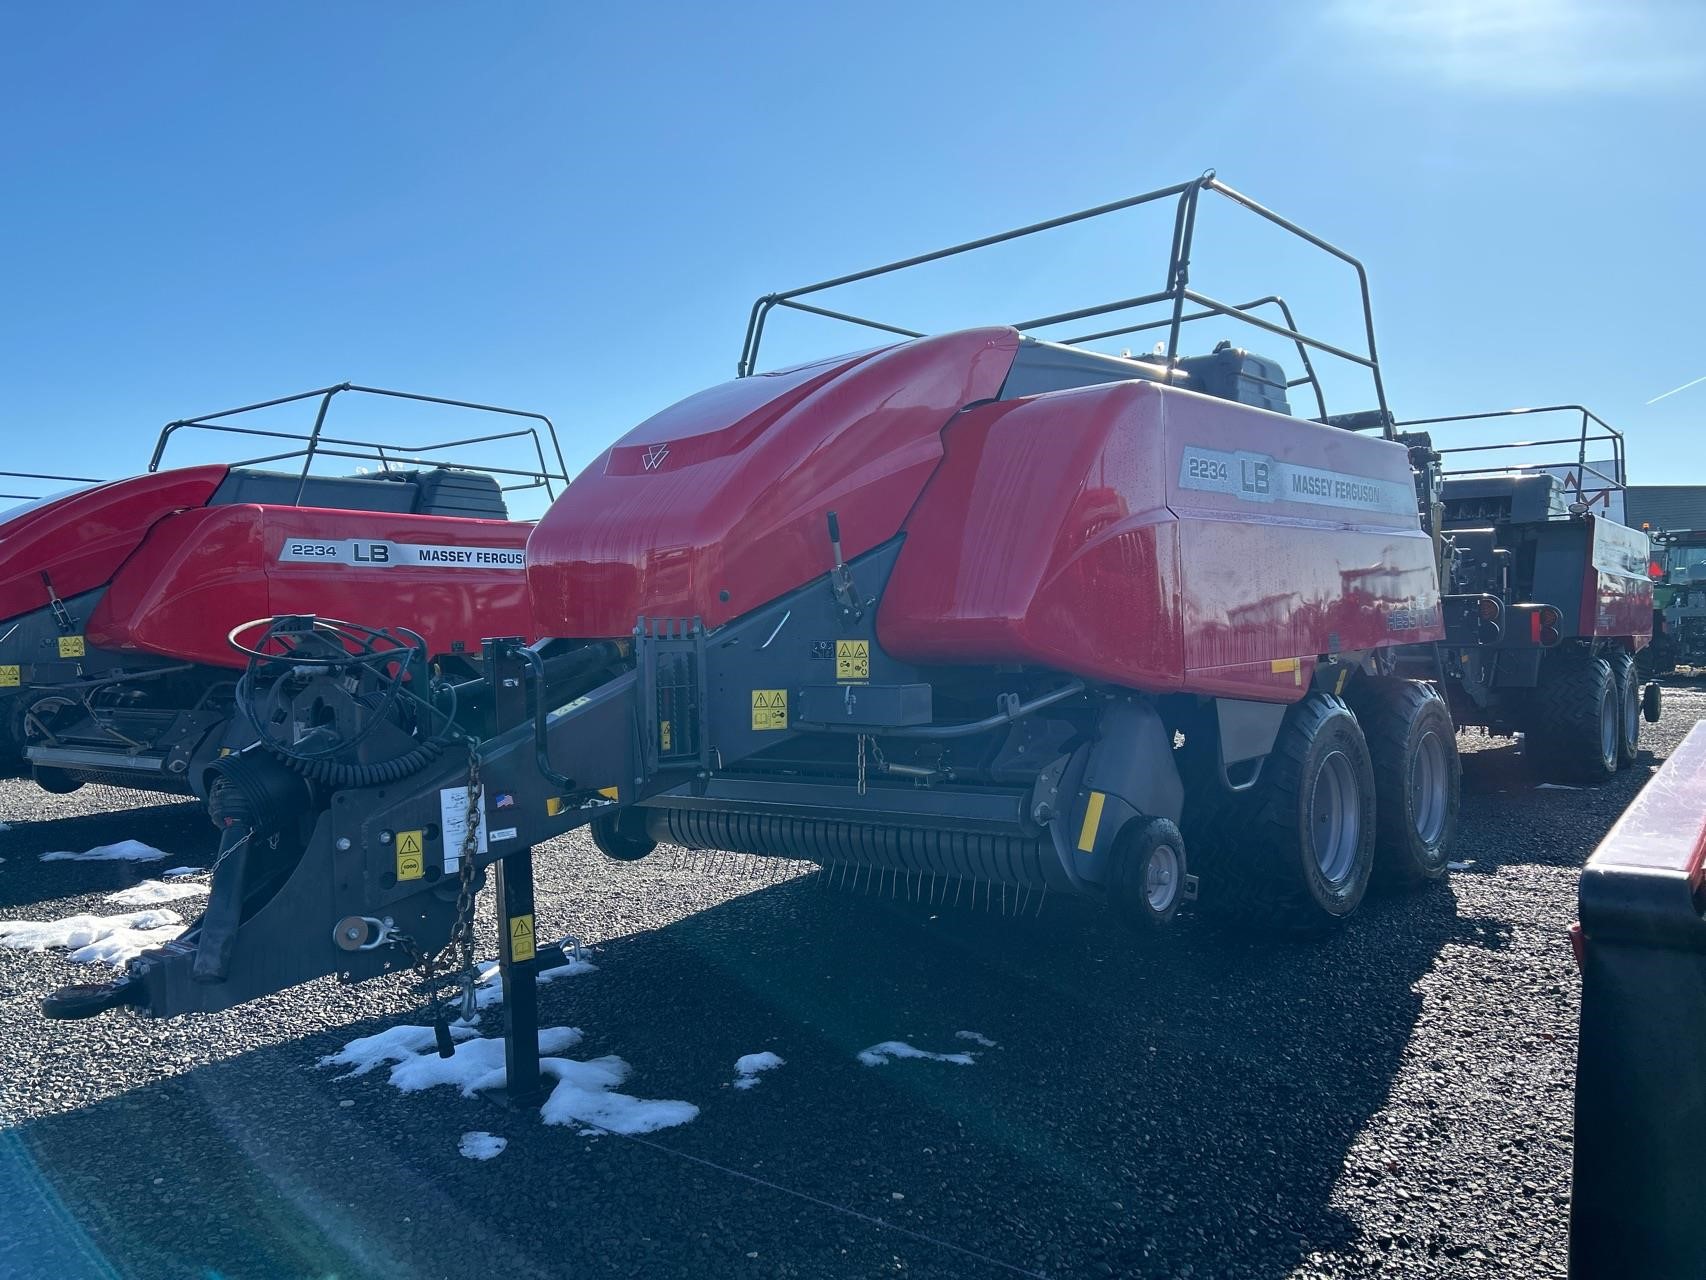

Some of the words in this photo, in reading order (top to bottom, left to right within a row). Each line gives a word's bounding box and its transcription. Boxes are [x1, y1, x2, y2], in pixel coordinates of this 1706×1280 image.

[1189, 458, 1228, 481] 2234
[1240, 459, 1270, 494] LB
[1292, 474, 1332, 496] MASSEY
[1335, 480, 1380, 503] FERGUSON
[291, 544, 337, 557] 2234
[353, 543, 389, 563] LB
[419, 549, 472, 563] MASSEY
